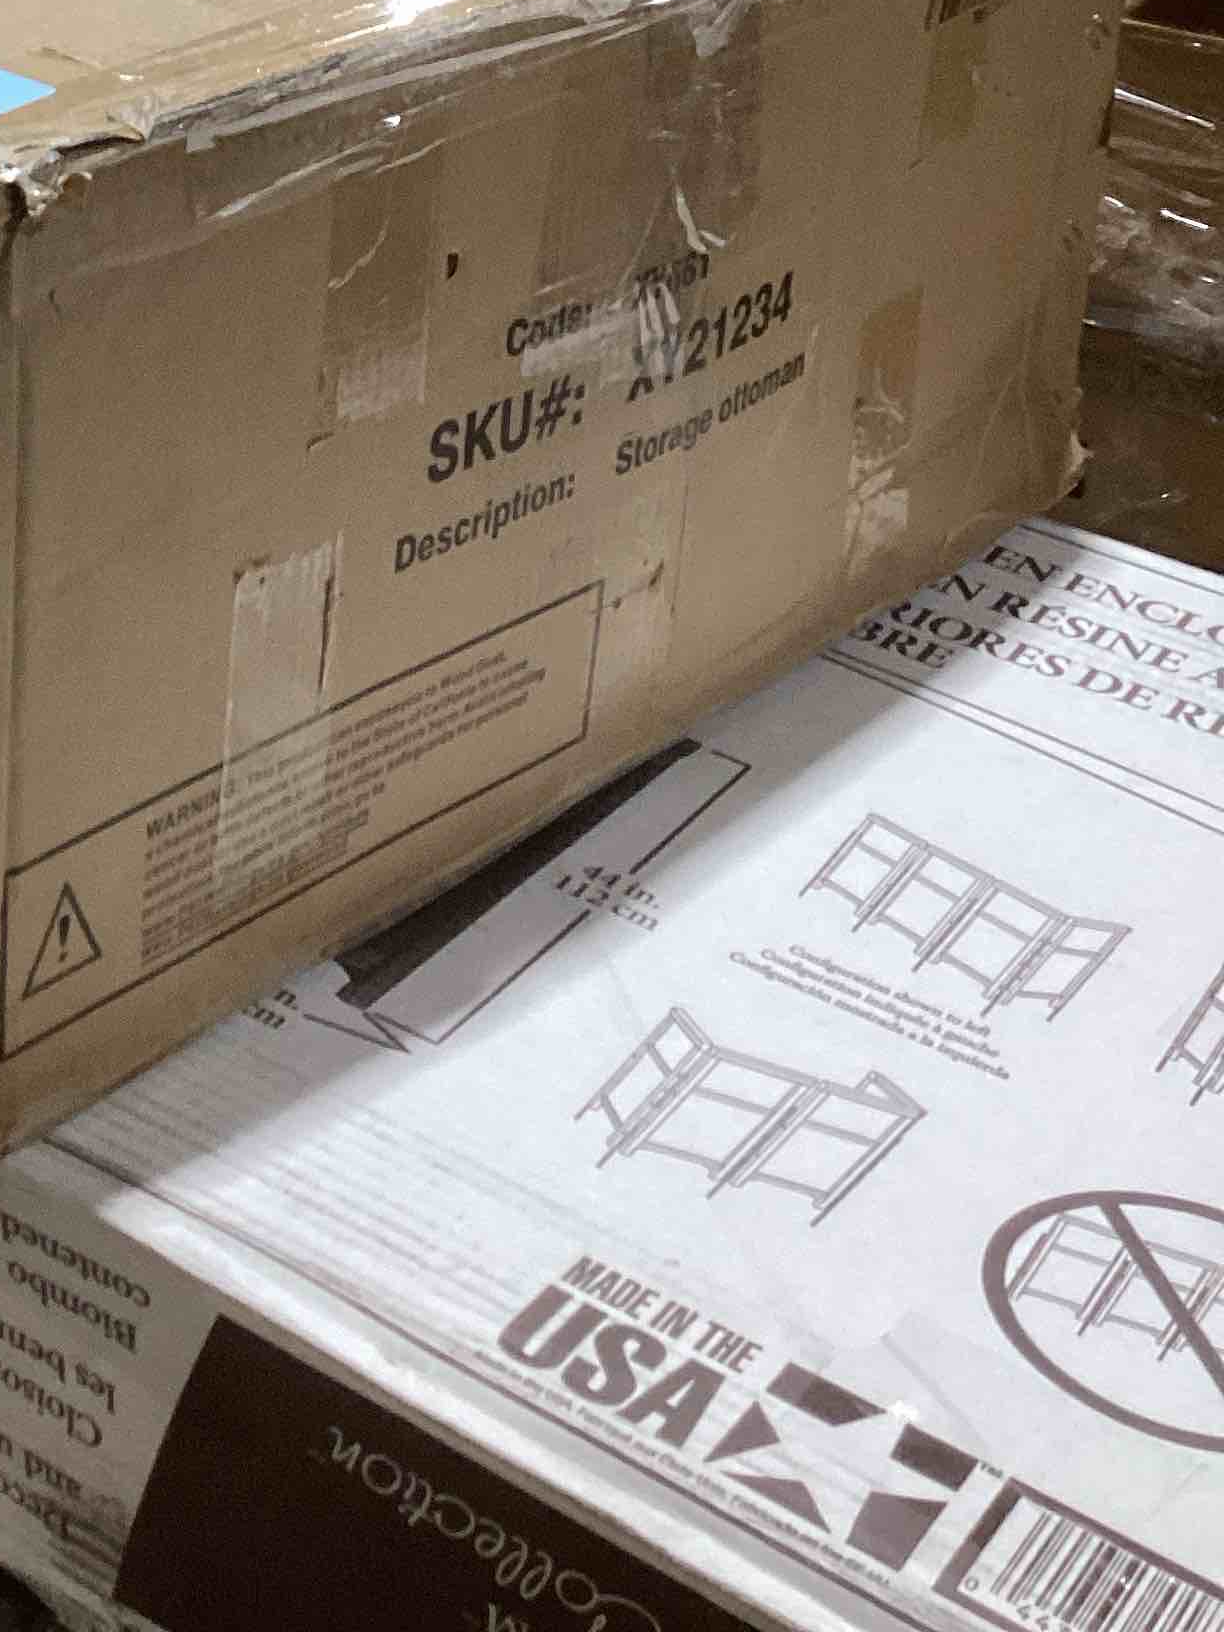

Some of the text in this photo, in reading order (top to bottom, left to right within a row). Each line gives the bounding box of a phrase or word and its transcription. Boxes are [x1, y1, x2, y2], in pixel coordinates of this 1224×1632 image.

[425, 270, 796, 484] SKU#: 21234
[394, 351, 807, 575] Description: Storage ottoman
[983, 544, 1066, 584] EN
[986, 590, 1192, 674] RESINE
[1071, 666, 1162, 712] DE
[555, 874, 661, 932] 112 cm
[581, 866, 662, 910] 44 in.
[760, 947, 863, 1000] Configuration
[788, 943, 892, 996] Configuration
[893, 991, 944, 1018] shown
[944, 1011, 963, 1028] to
[9, 1261, 138, 1352] Biombo
[560, 1254, 764, 1375] MADE IN THE
[74, 1366, 119, 1416] les
[496, 1283, 728, 1450] USA
[23, 1449, 81, 1498] and
